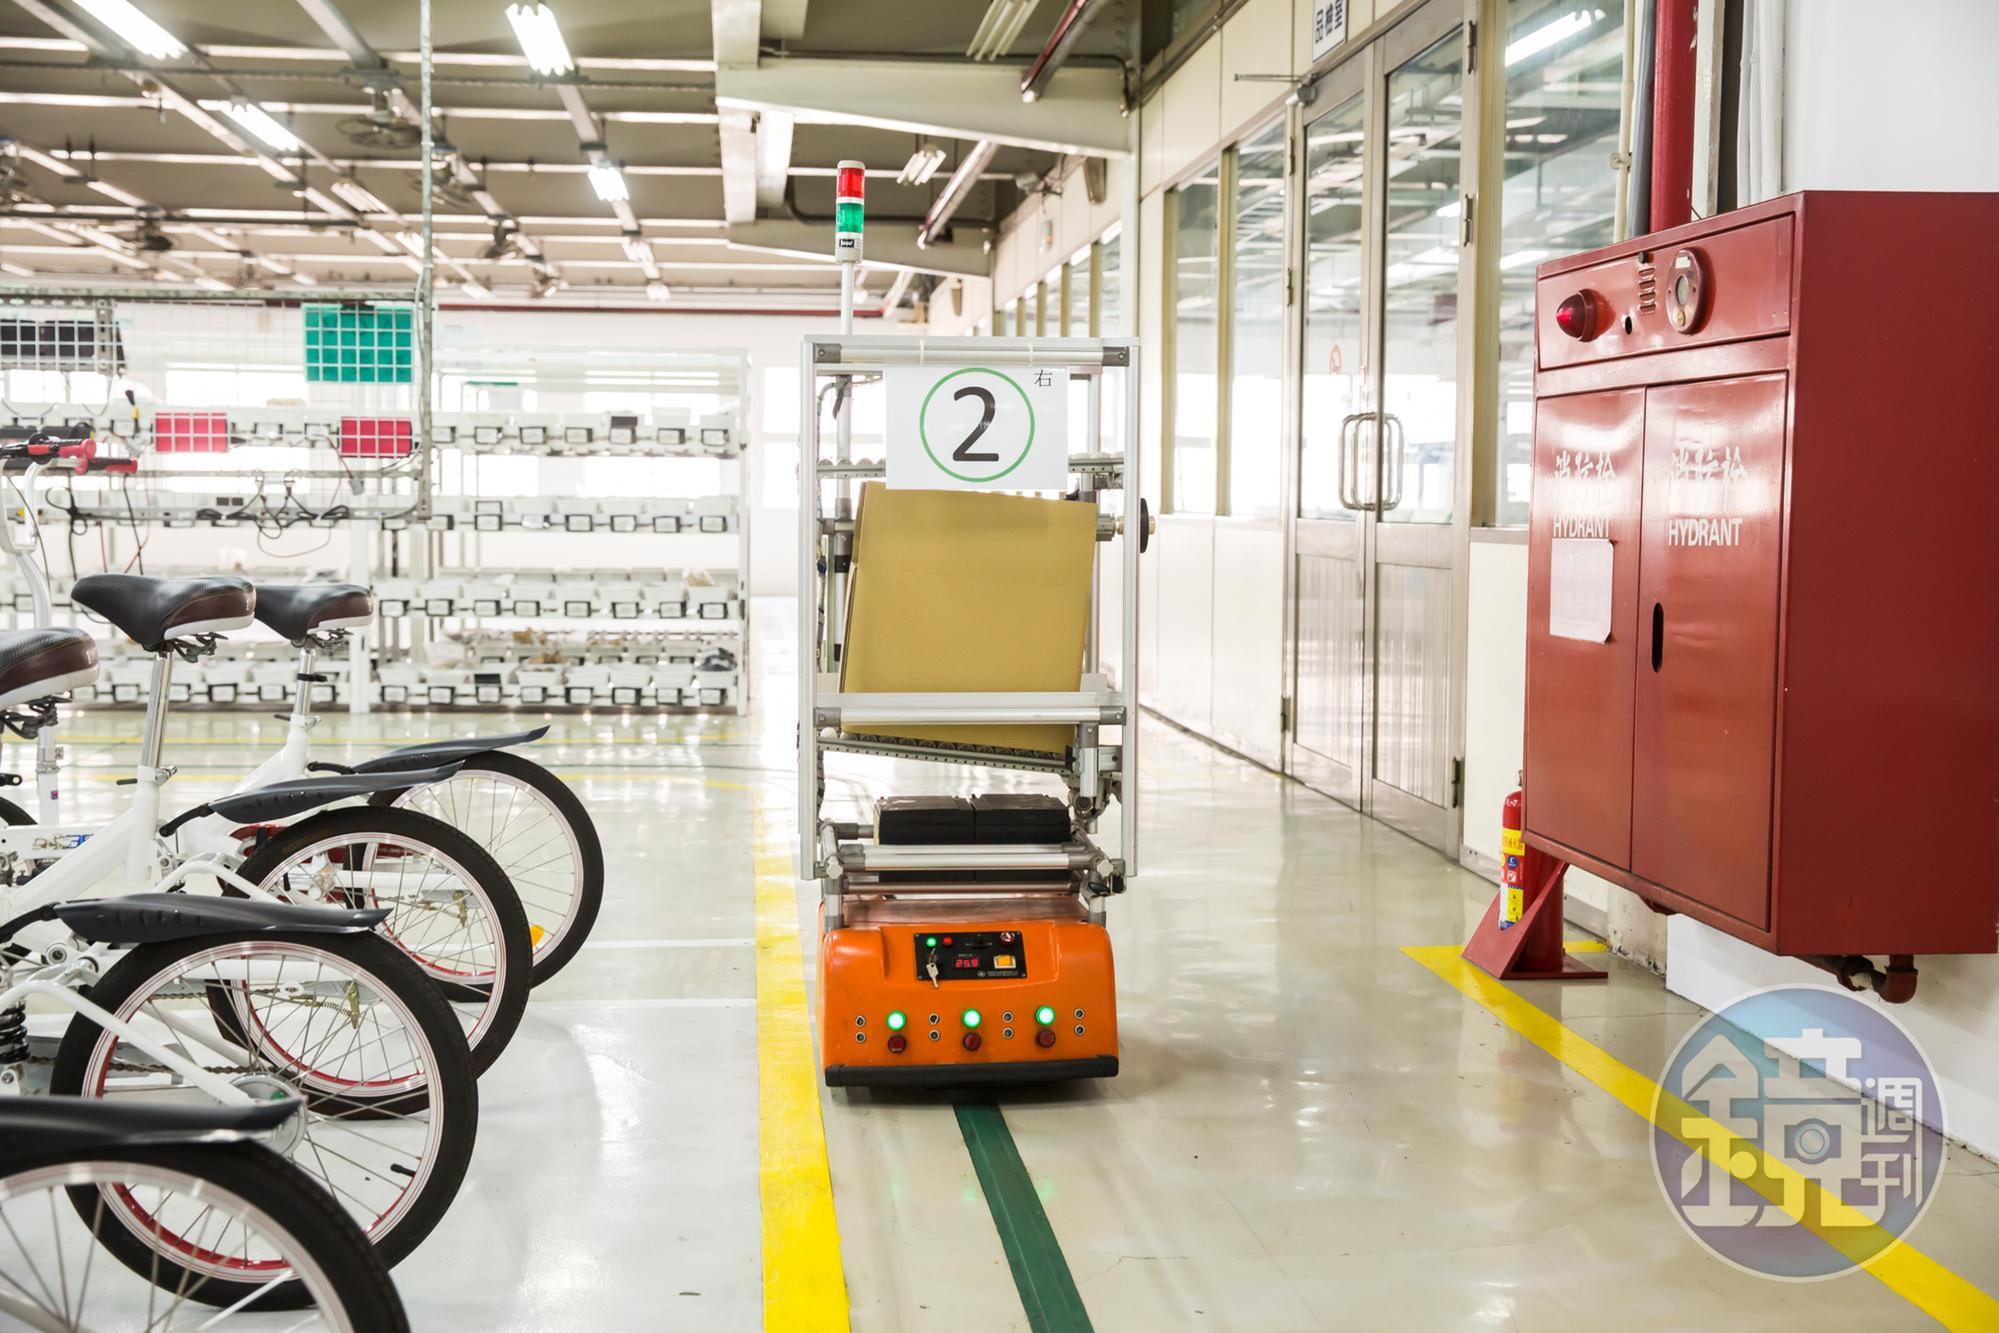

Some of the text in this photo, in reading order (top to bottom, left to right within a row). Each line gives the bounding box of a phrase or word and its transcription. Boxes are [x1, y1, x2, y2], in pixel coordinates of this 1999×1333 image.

[1034, 369, 1053, 388] 右
[952, 386, 1000, 462] 2
[1553, 514, 1611, 538] HYDRANT
[1668, 517, 1743, 547] HYDRANT
